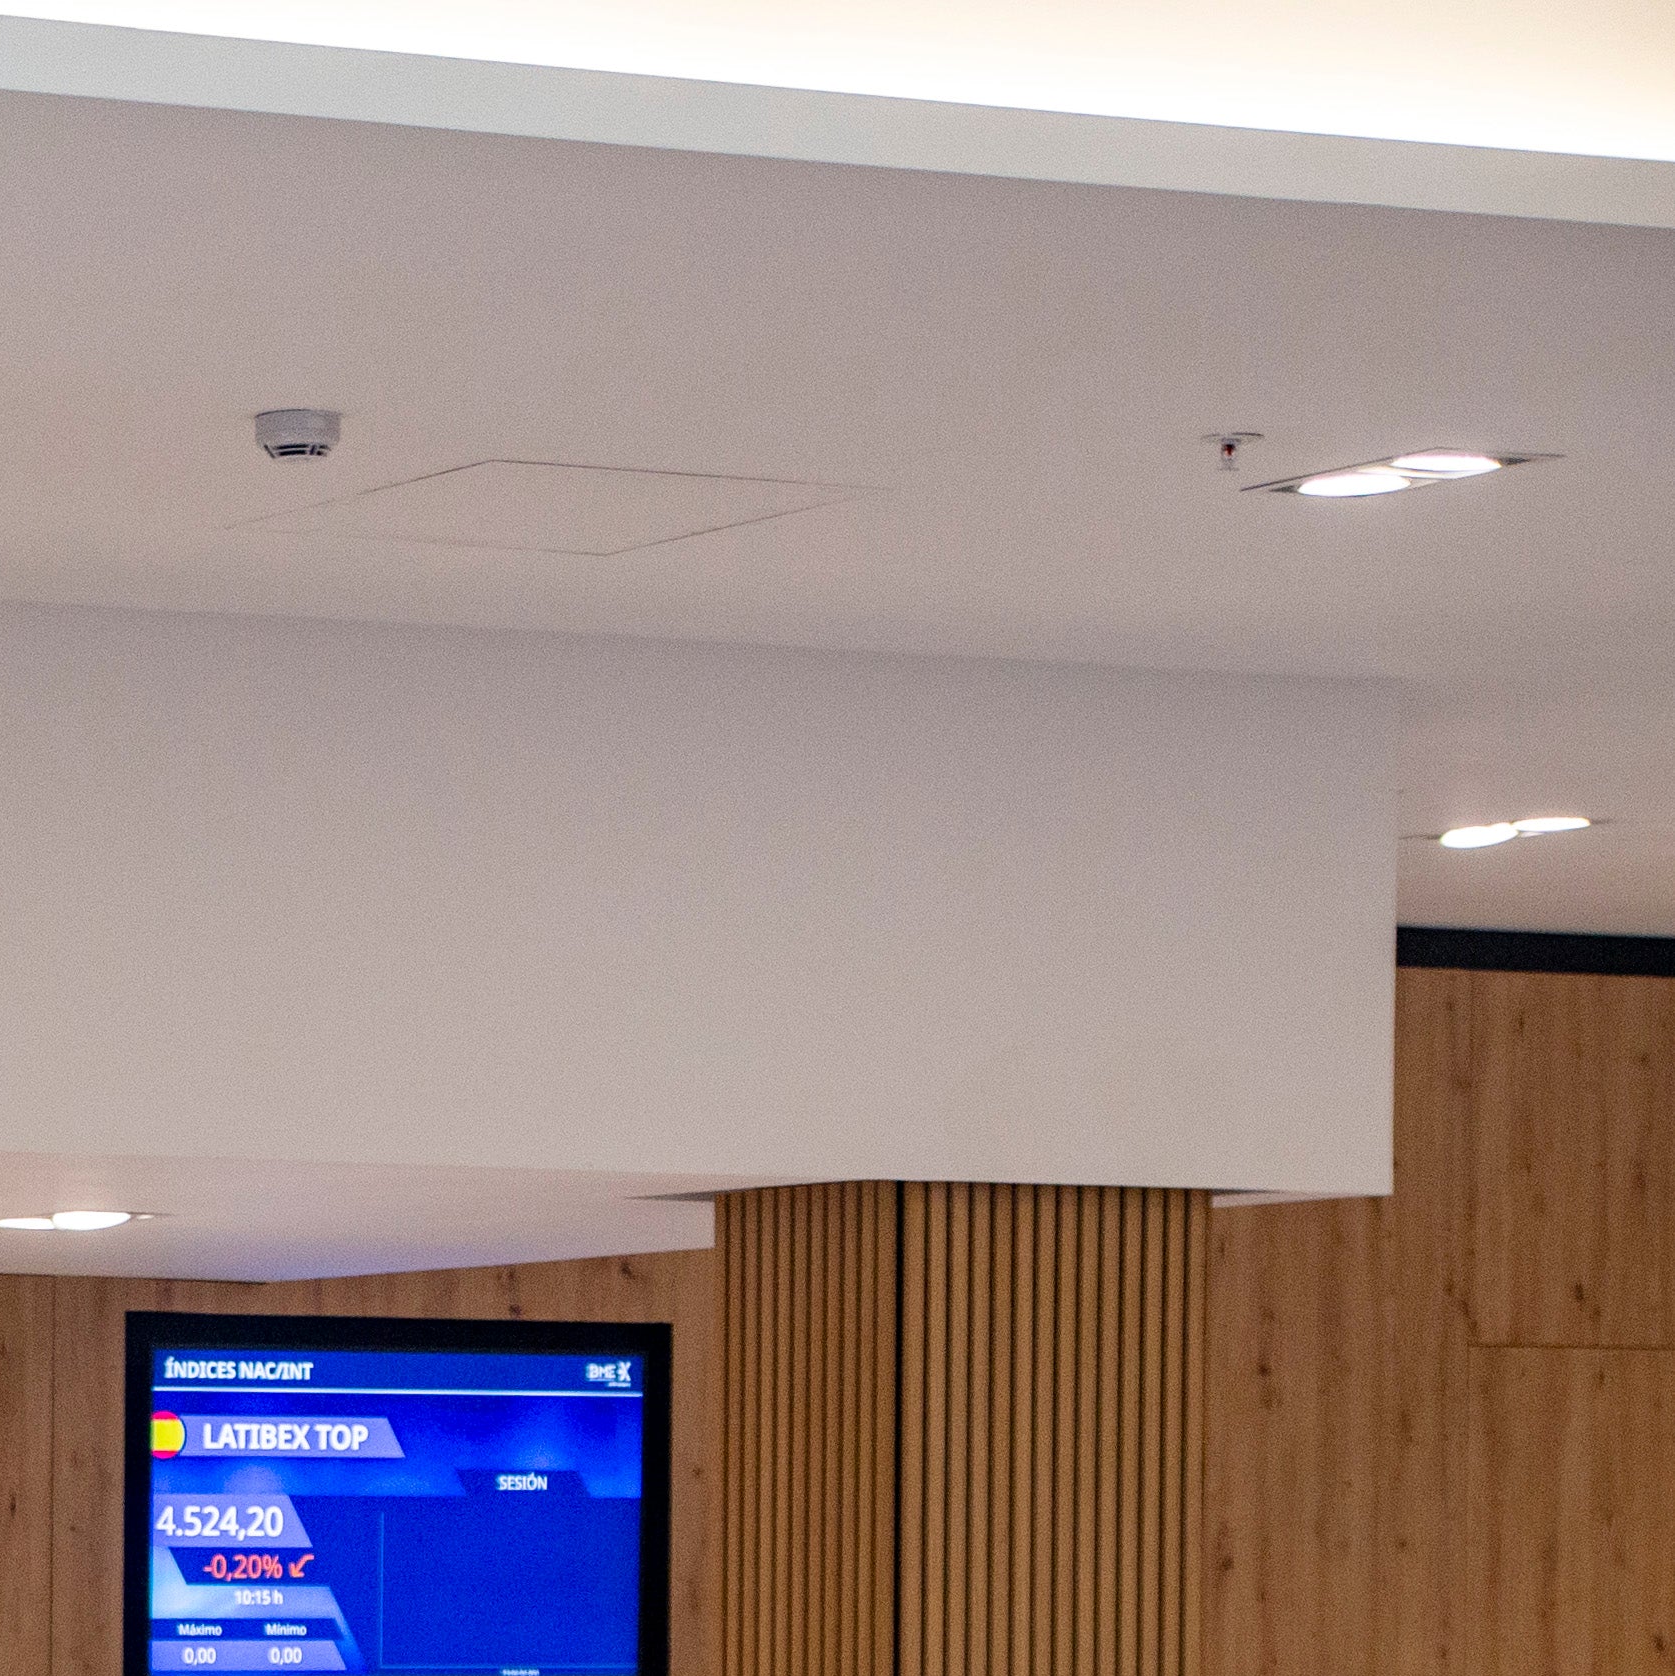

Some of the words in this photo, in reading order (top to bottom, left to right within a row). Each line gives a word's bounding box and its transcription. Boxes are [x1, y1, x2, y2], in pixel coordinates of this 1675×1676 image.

[164, 1356, 236, 1379] ÍNDICES
[239, 1361, 314, 1381] NAC/INT
[202, 1423, 310, 1450] LATIBEX
[315, 1424, 369, 1451] TOP
[497, 1472, 548, 1491] SESIÓN
[156, 1505, 284, 1541] 4.524,20
[203, 1554, 283, 1581] -0,20%
[234, 1590, 271, 1605] 10:15
[273, 1590, 284, 1605] h
[178, 1623, 223, 1636] Máximo
[184, 1648, 217, 1666] 0,00
[270, 1647, 303, 1666] 0,00
